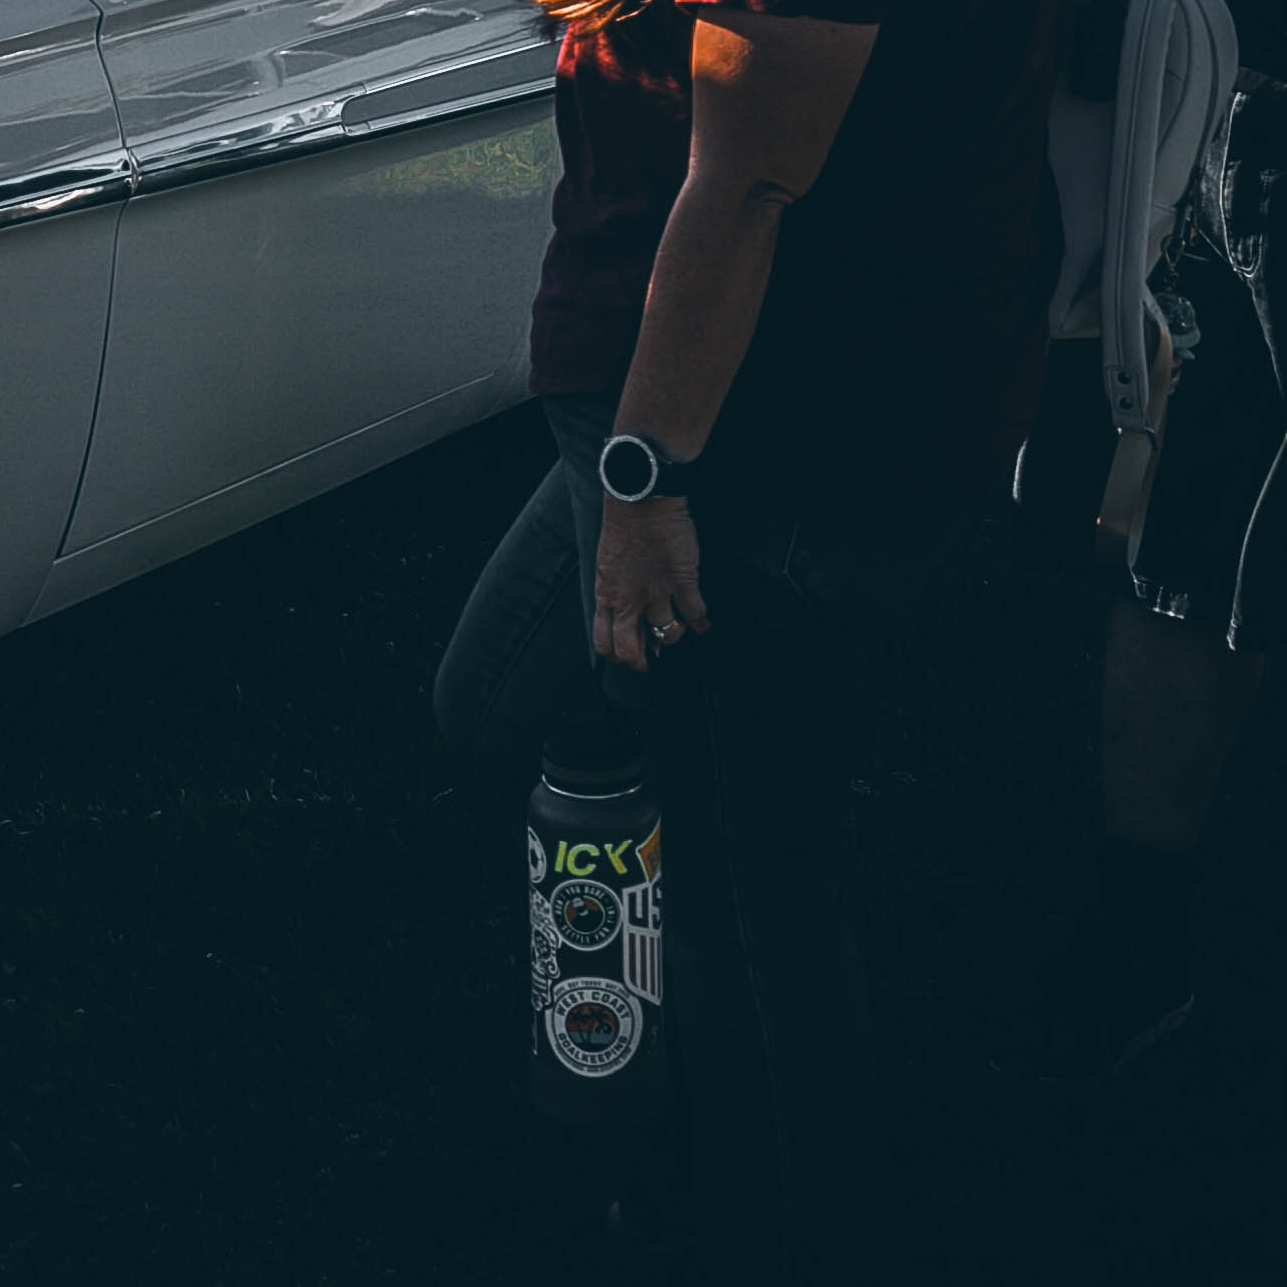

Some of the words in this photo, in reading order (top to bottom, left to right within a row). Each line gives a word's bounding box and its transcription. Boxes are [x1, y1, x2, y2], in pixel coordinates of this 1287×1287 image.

[556, 991, 585, 1017] WEST
[591, 991, 631, 1019] COAST
[558, 1032, 629, 1064] GOALKEEPING
